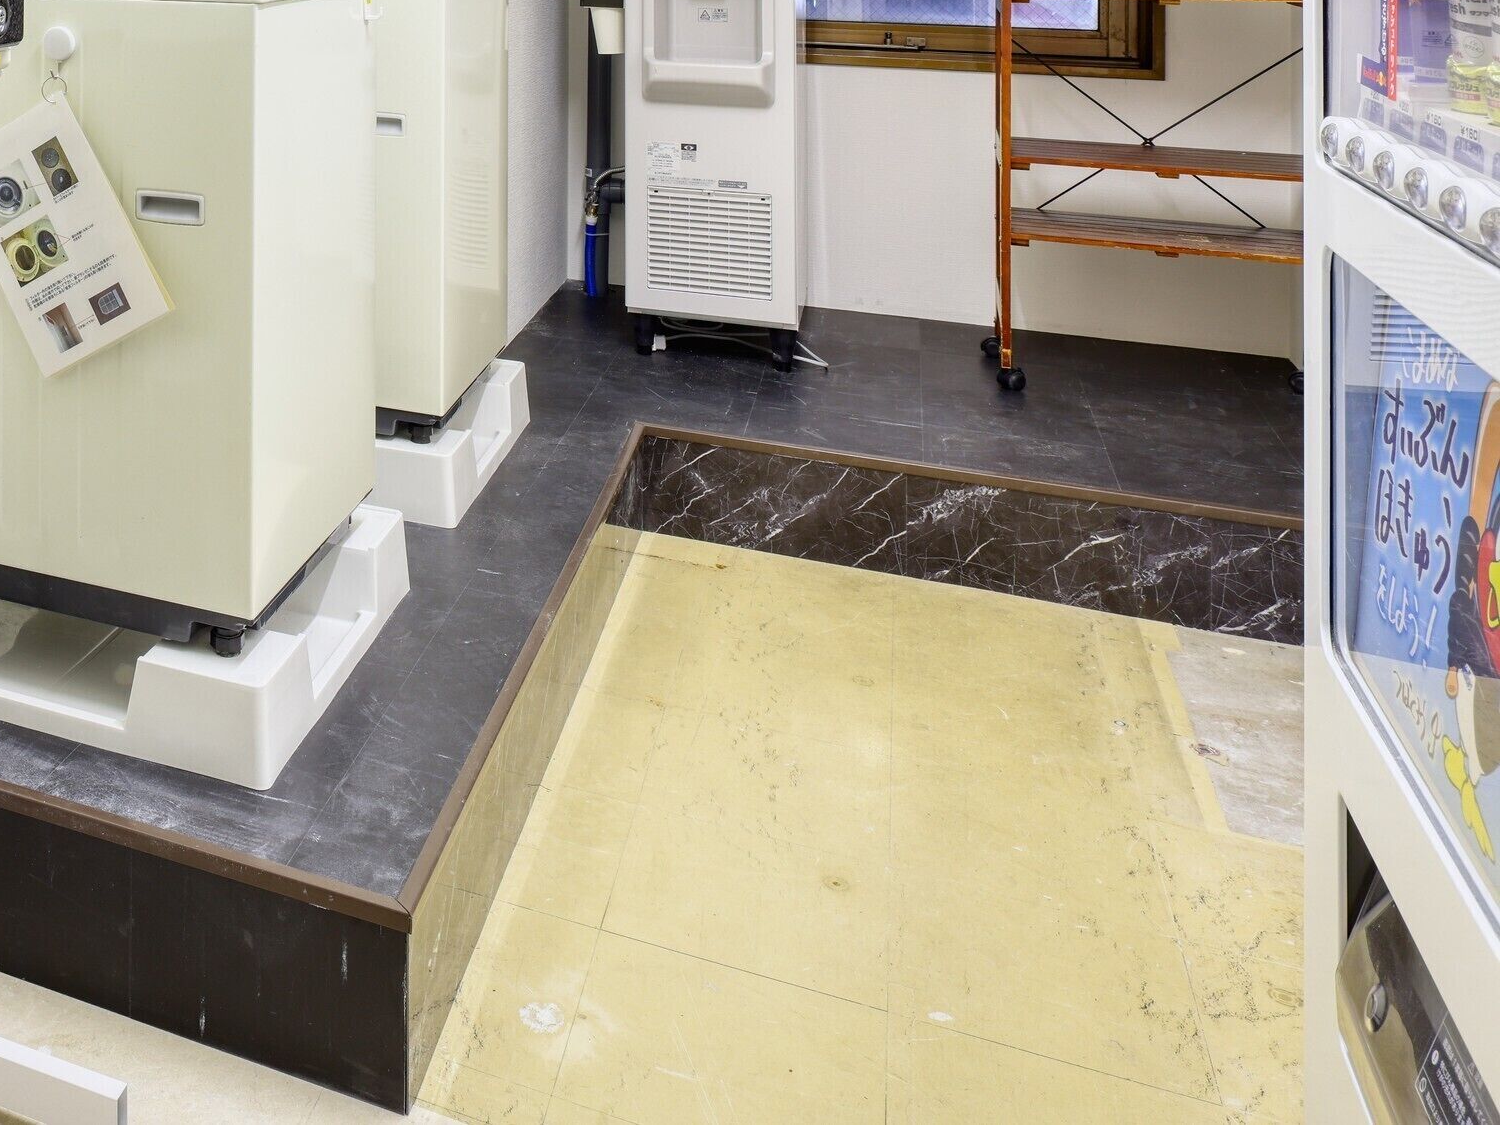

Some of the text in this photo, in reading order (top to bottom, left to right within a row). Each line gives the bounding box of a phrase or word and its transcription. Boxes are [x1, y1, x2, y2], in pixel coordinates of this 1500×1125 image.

[1460, 126, 1478, 141] ¥160
[1383, 378, 1469, 488] すいぶん
[1375, 469, 1450, 595] ほきゅう
